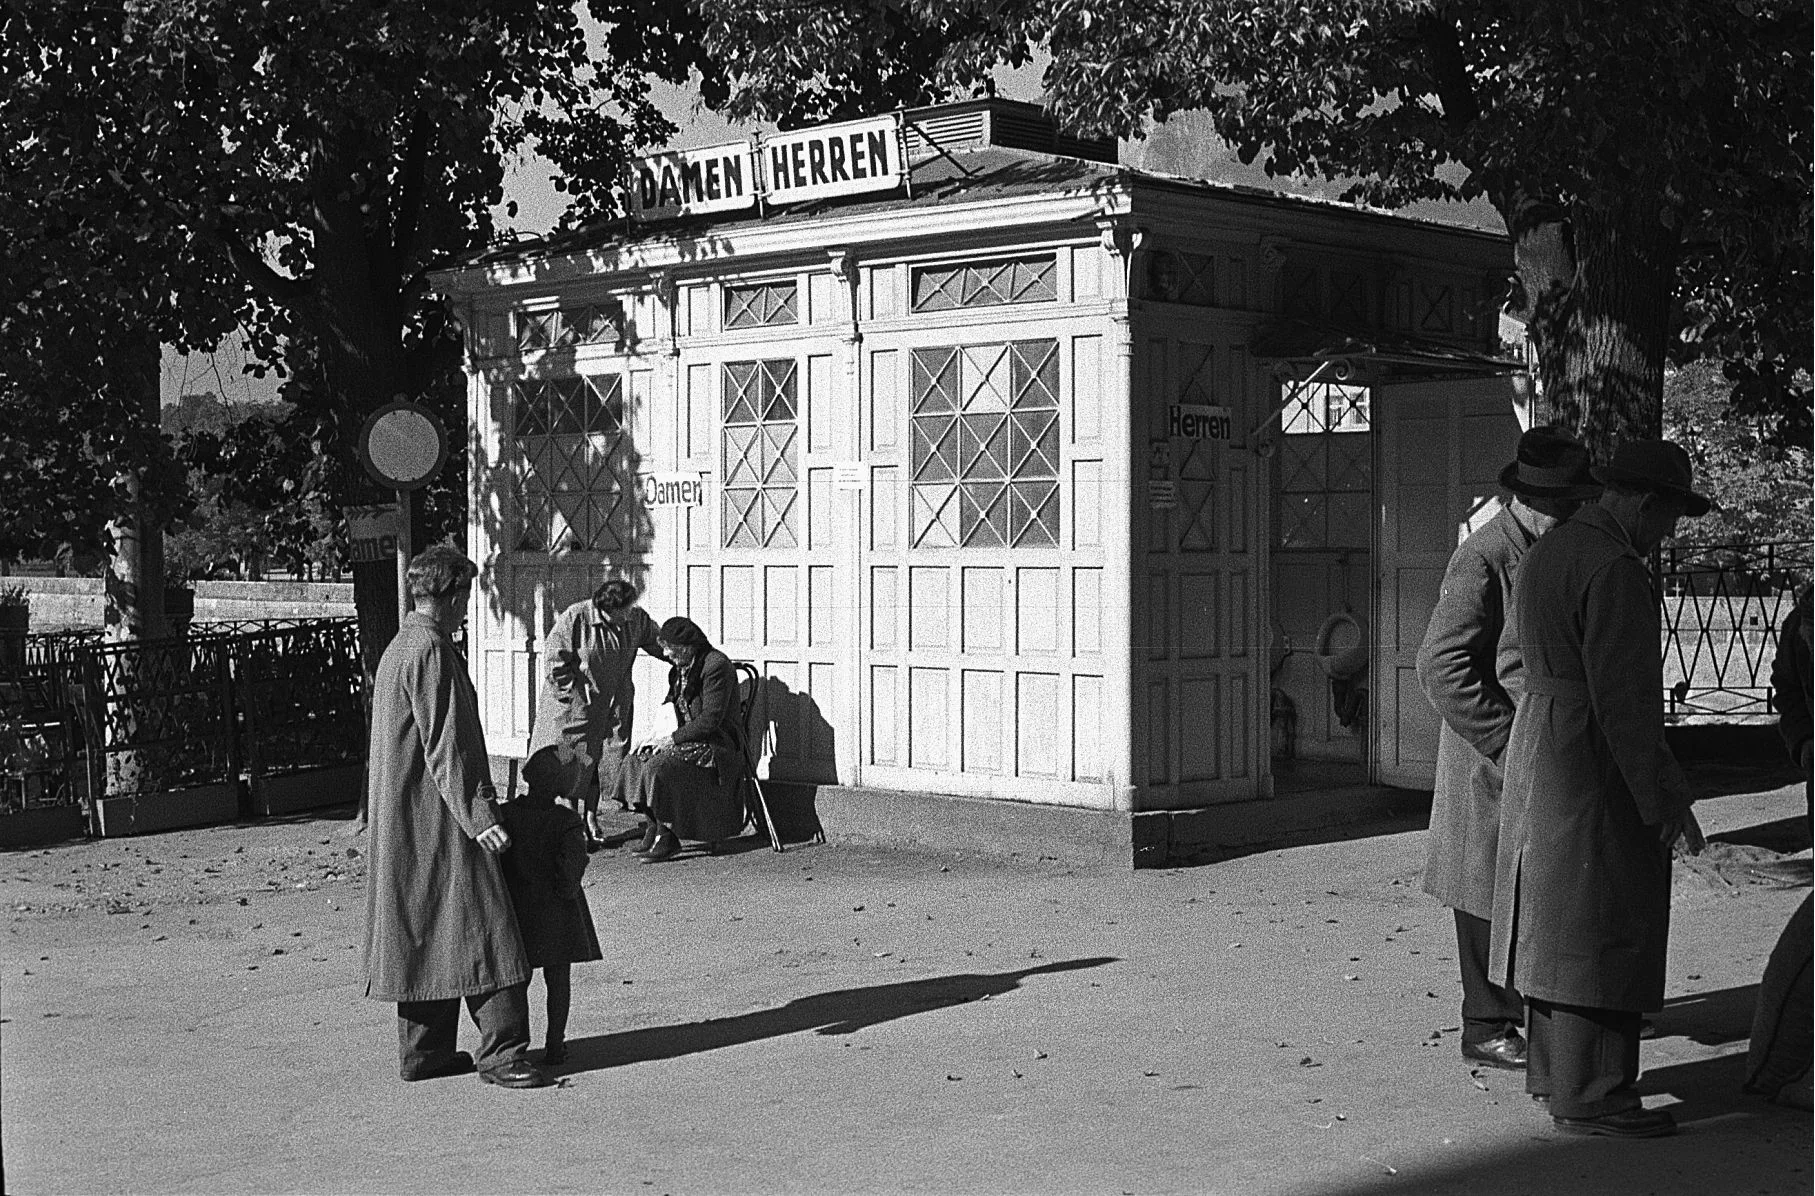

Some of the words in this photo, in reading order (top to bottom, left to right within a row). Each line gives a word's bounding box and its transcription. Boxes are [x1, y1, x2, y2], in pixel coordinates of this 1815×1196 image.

[640, 154, 743, 209] DAMEN
[771, 129, 889, 190] HERREN
[1169, 405, 1231, 440] Herren
[351, 535, 397, 558] ame
